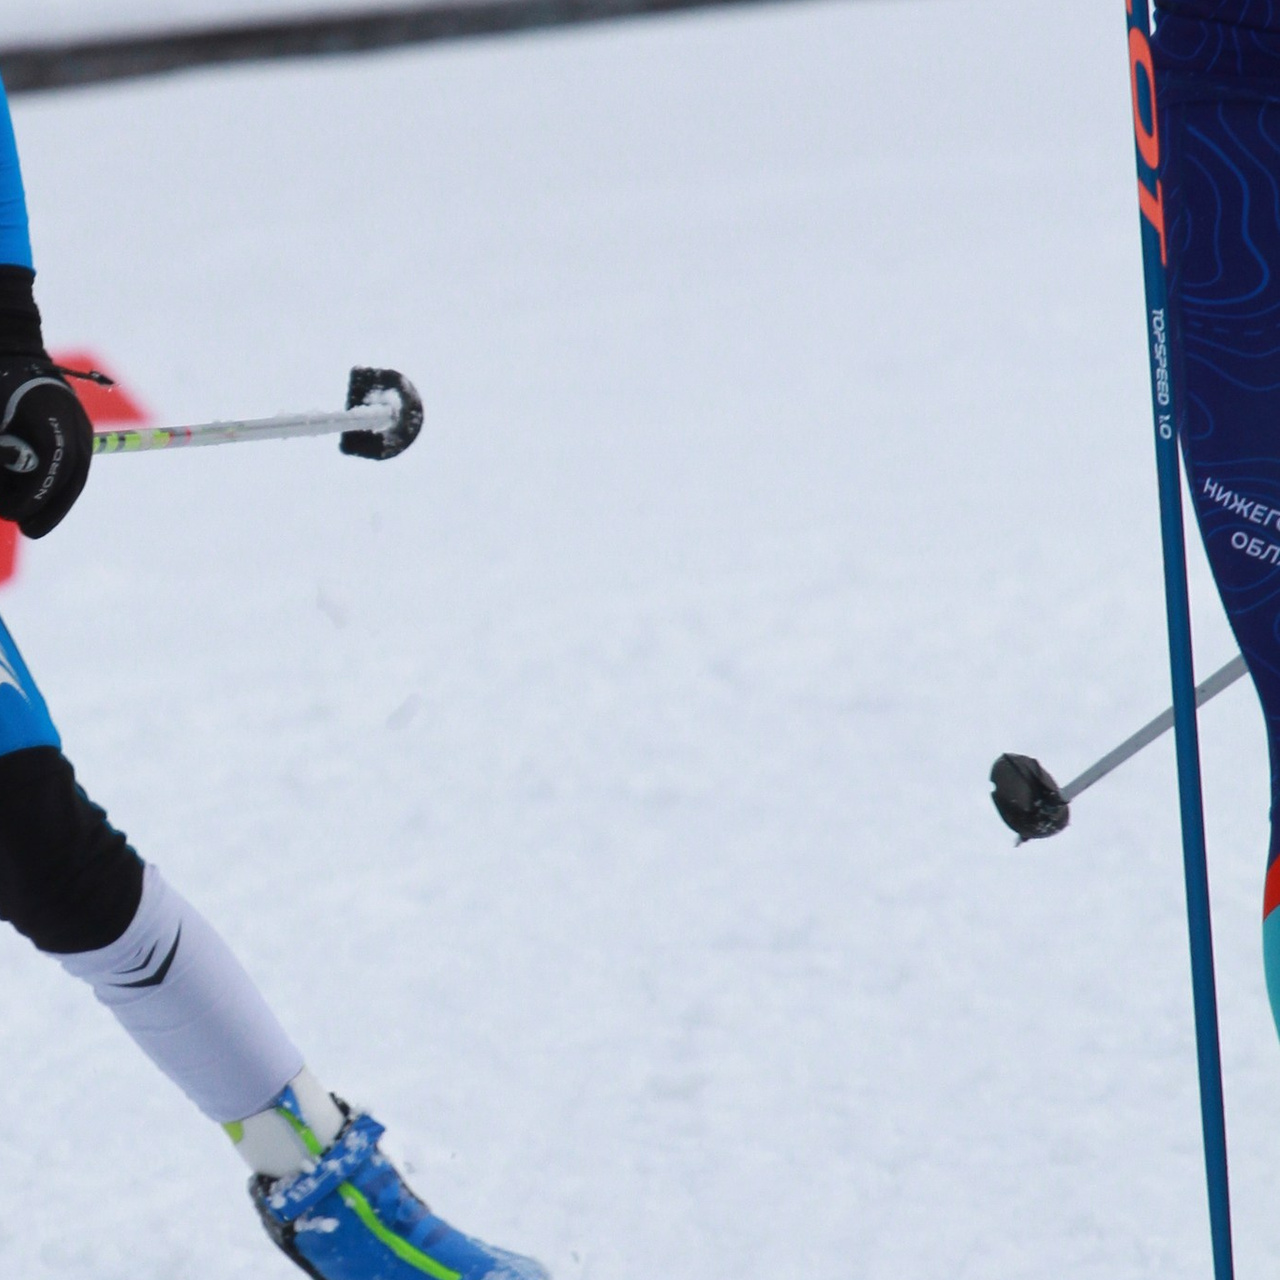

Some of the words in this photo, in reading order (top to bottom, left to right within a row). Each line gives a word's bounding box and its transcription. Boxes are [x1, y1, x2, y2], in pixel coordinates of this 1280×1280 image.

[1152, 307, 1170, 406] TOPSPEED
[1203, 477, 1280, 532] НИЖЕГ
[1231, 531, 1280, 566] ОБЛ
